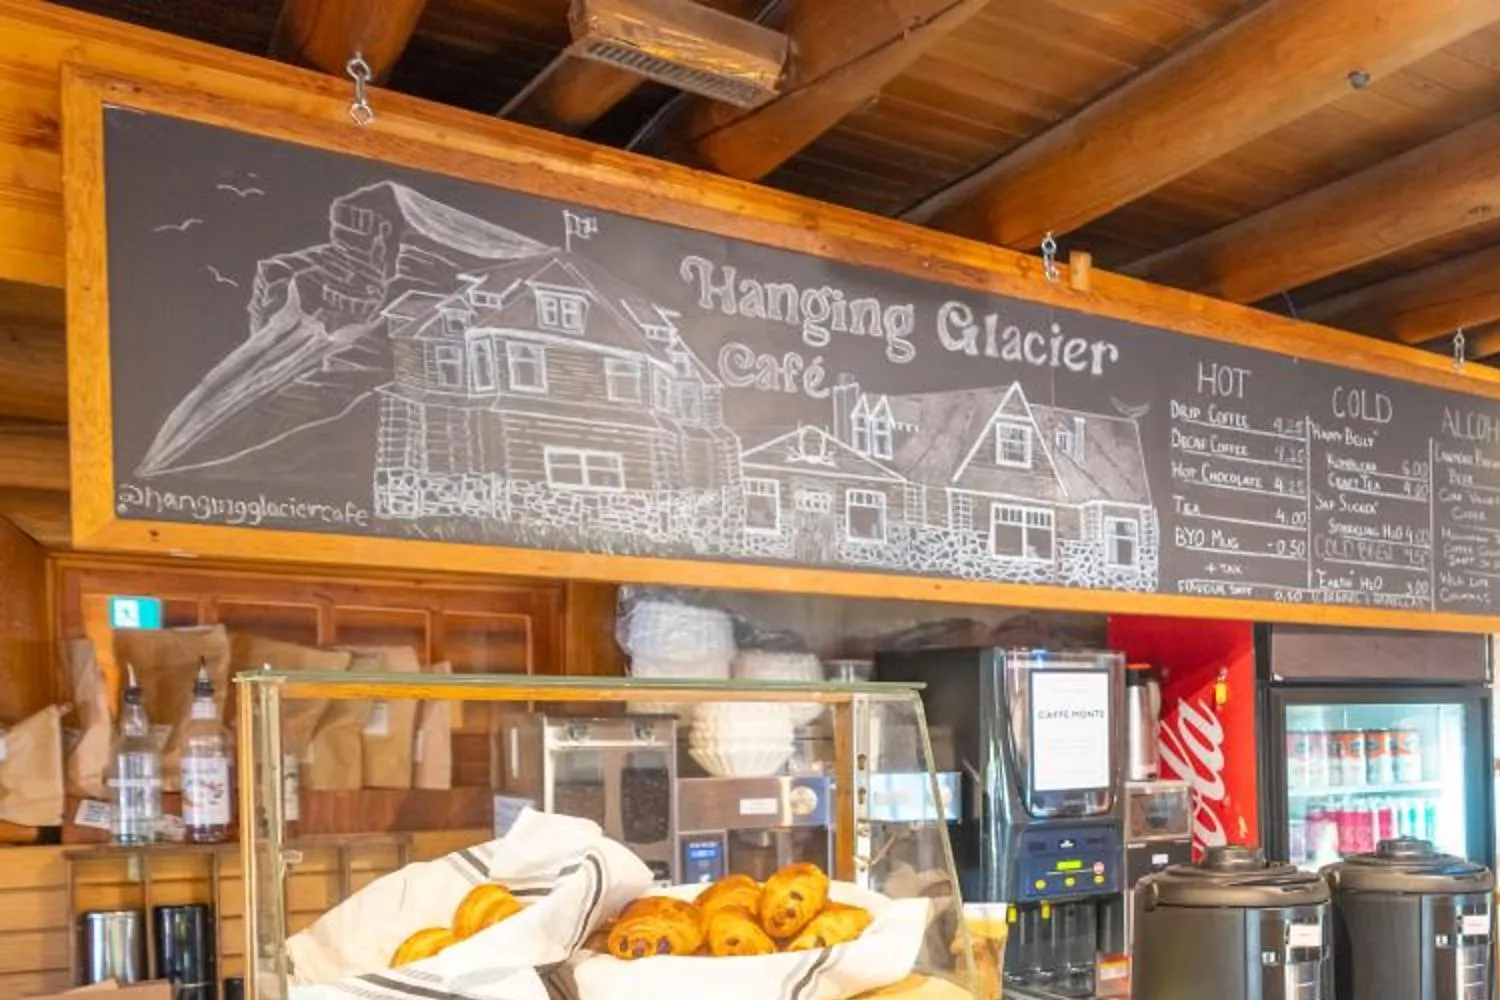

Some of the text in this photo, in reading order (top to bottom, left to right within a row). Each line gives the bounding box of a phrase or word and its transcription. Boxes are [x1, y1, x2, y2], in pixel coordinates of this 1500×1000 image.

[680, 255, 1120, 376] Hanging Glacier
[718, 342, 832, 399] Café
[1197, 361, 1251, 399] HOT
[1332, 386, 1393, 423] COLD
[118, 484, 369, 526] @hangingglaciercafe
[1175, 526, 1205, 547] BYO
